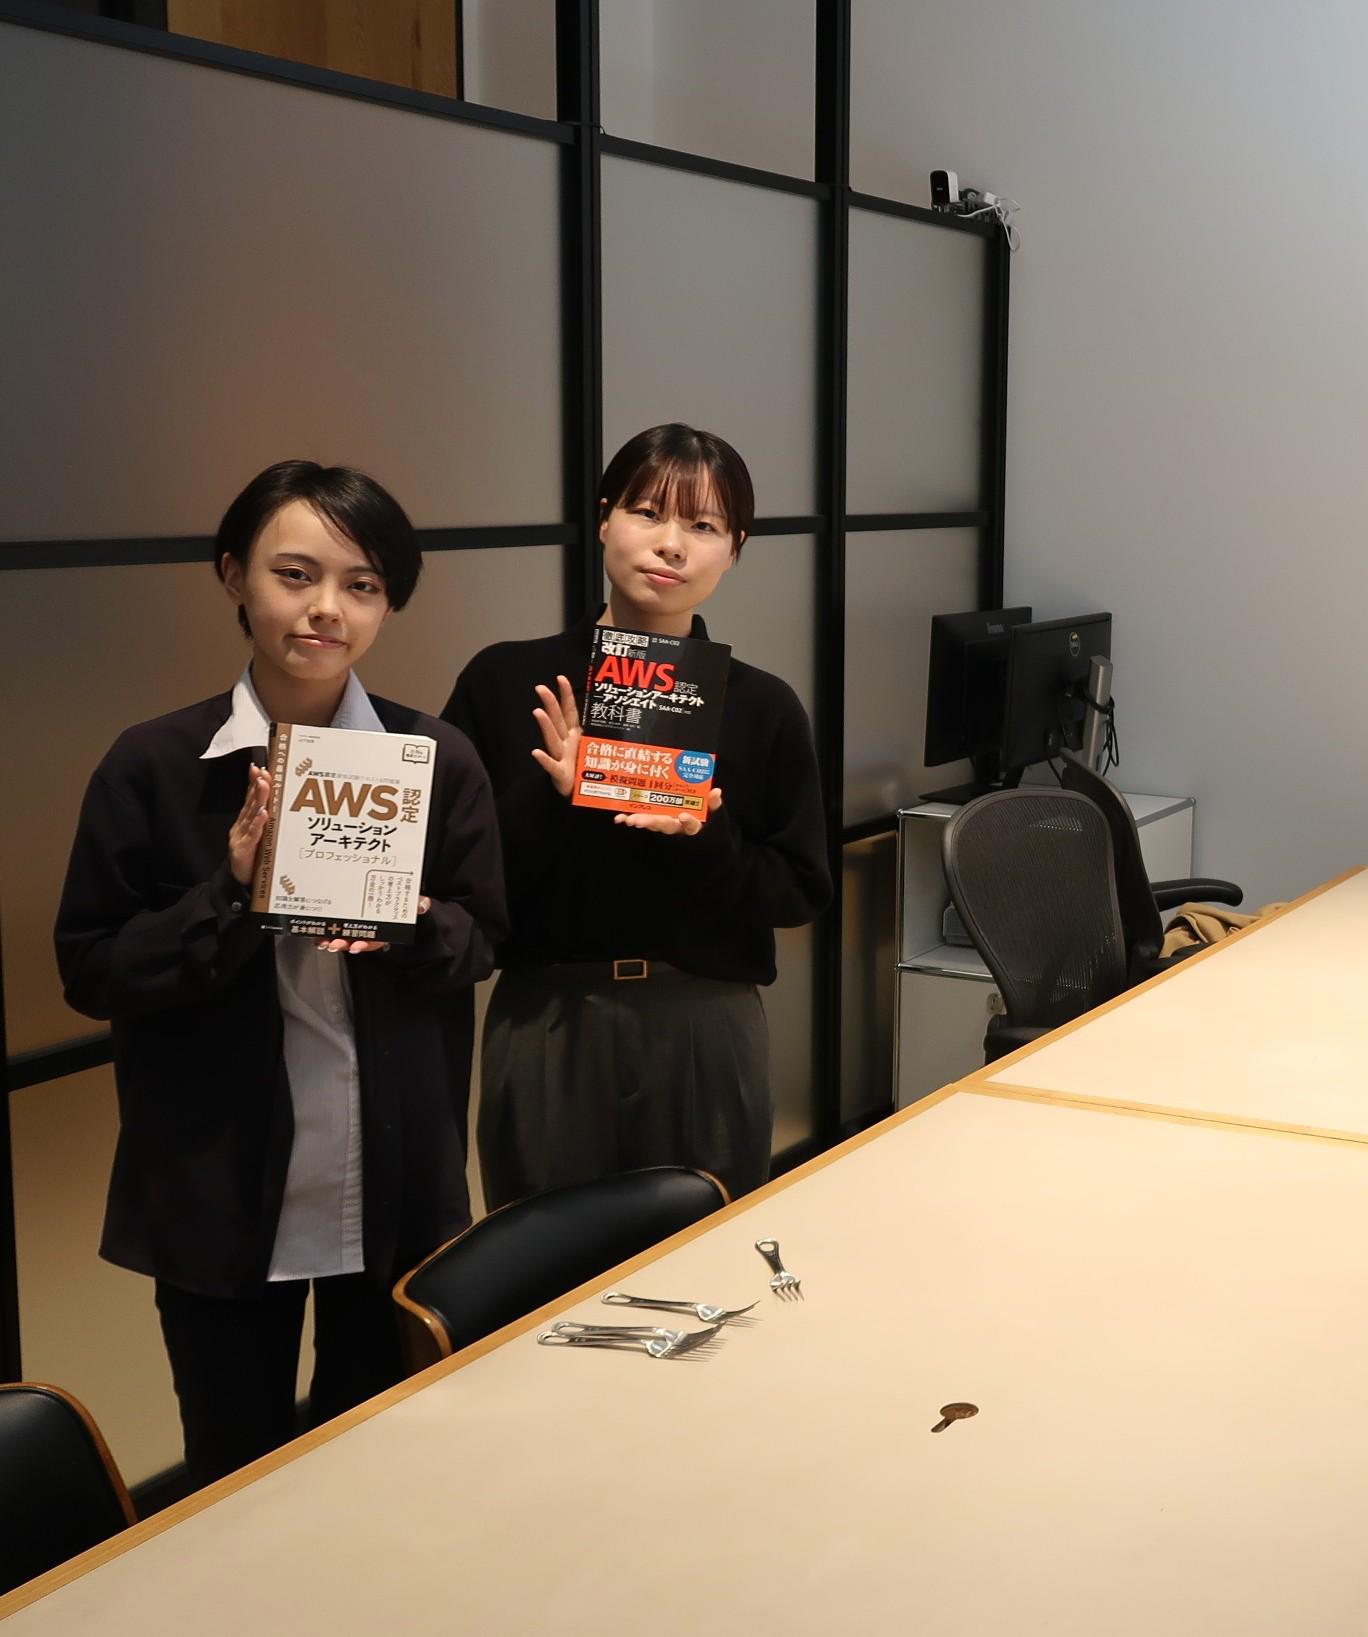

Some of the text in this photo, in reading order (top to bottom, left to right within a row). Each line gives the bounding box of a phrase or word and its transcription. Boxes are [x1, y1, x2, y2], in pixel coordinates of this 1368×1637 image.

[594, 655, 675, 692] AWS
[594, 682, 705, 707] ソリューションアーキテクト
[673, 680, 699, 696] 認定
[590, 701, 642, 724] 教科書
[586, 741, 673, 765] 合格に直結する
[584, 755, 670, 779] 知識が身に付く
[290, 777, 422, 823] AWS 認定
[307, 816, 398, 836] ソリューション
[310, 833, 391, 853] アーキテクト
